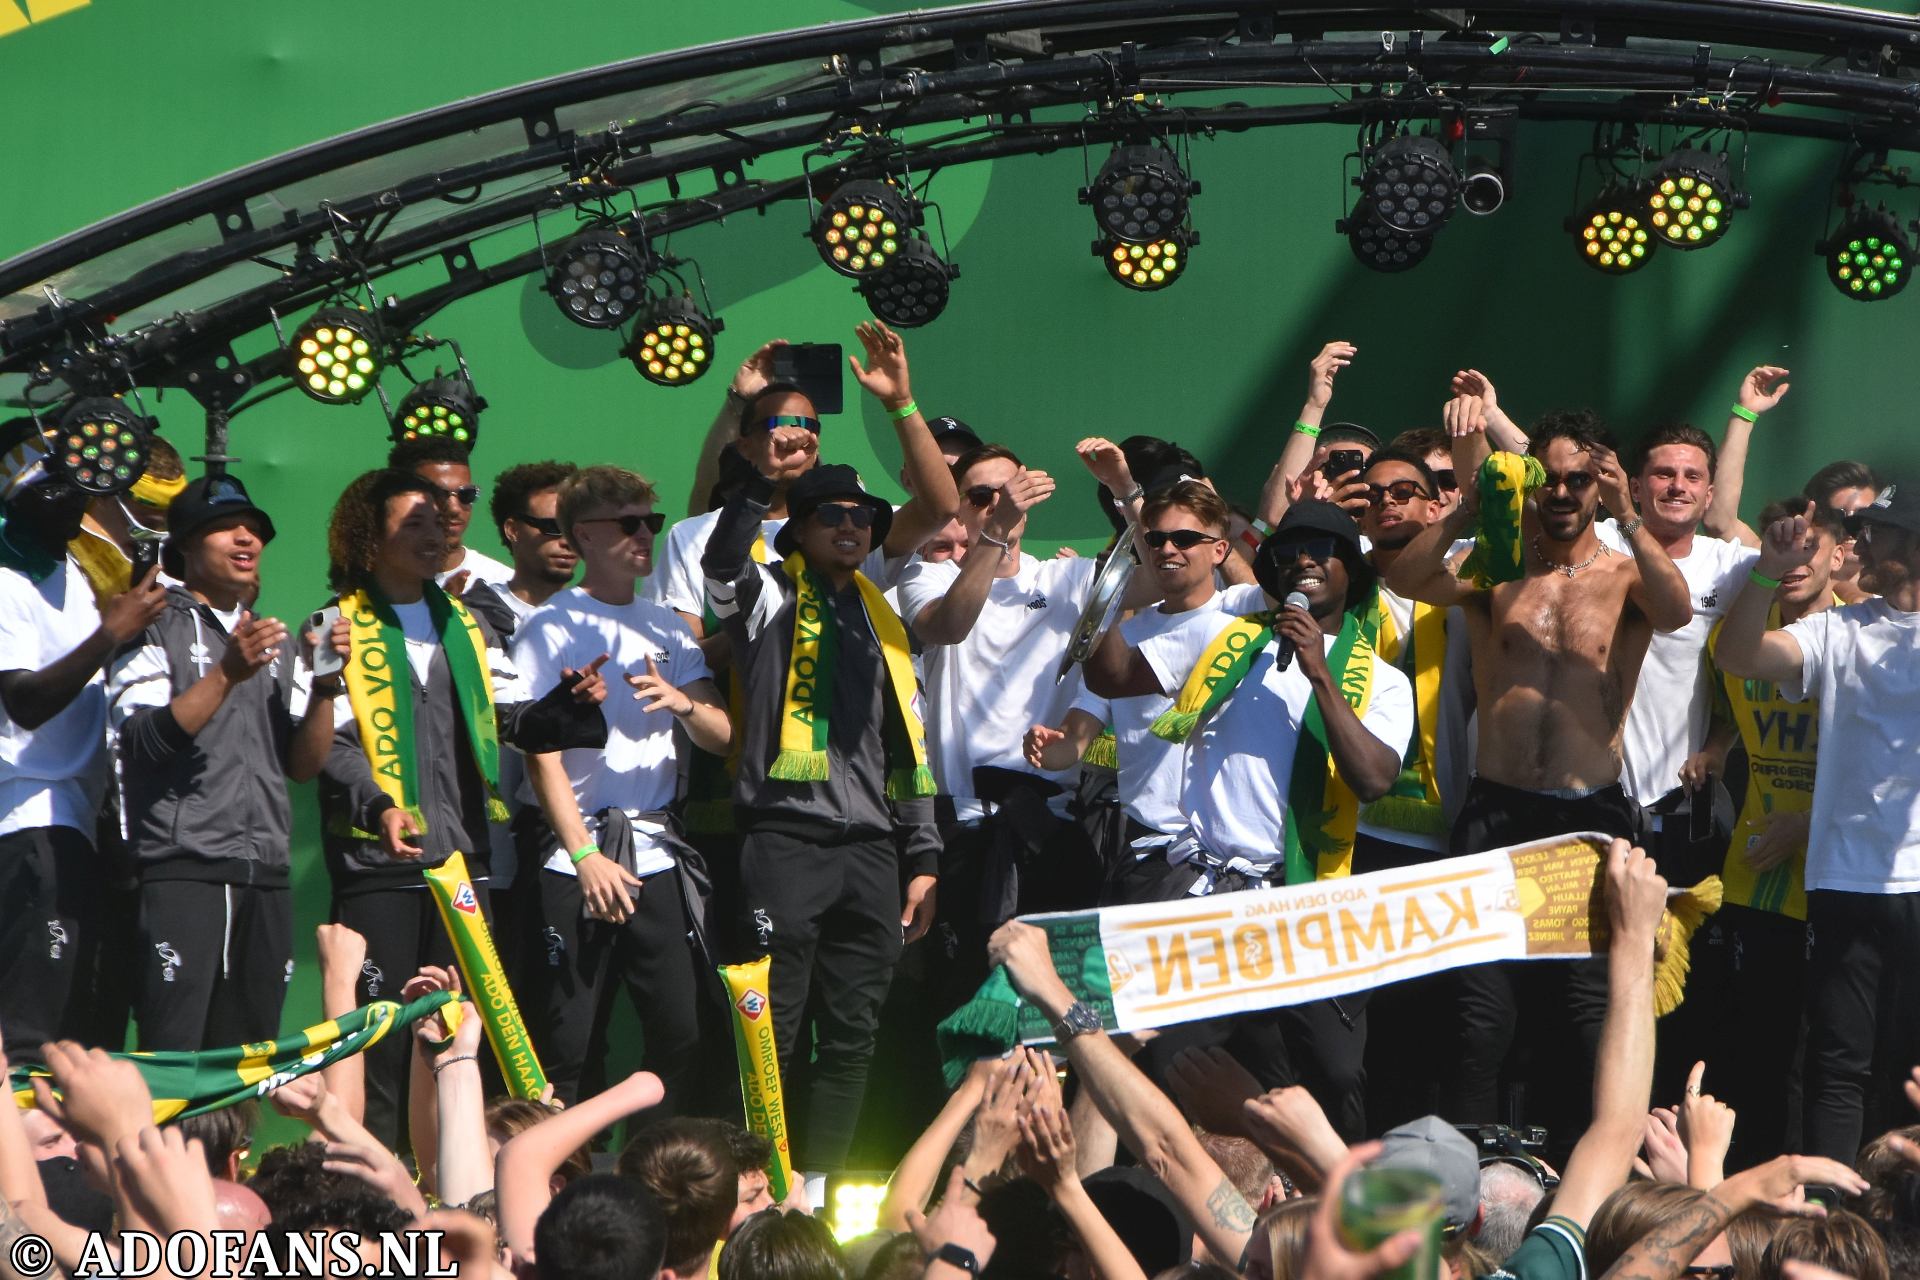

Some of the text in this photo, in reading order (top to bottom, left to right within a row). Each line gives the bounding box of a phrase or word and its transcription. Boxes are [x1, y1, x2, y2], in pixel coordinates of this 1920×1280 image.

[791, 656, 817, 728] ADO
[1203, 631, 1251, 692] ADO
[371, 706, 402, 780] ADO
[480, 972, 504, 1010] ADO
[496, 1009, 522, 1050] DEN
[747, 1071, 765, 1108] ADO
[758, 1026, 778, 1094] OMROEP
[768, 1098, 784, 1140] WEST
